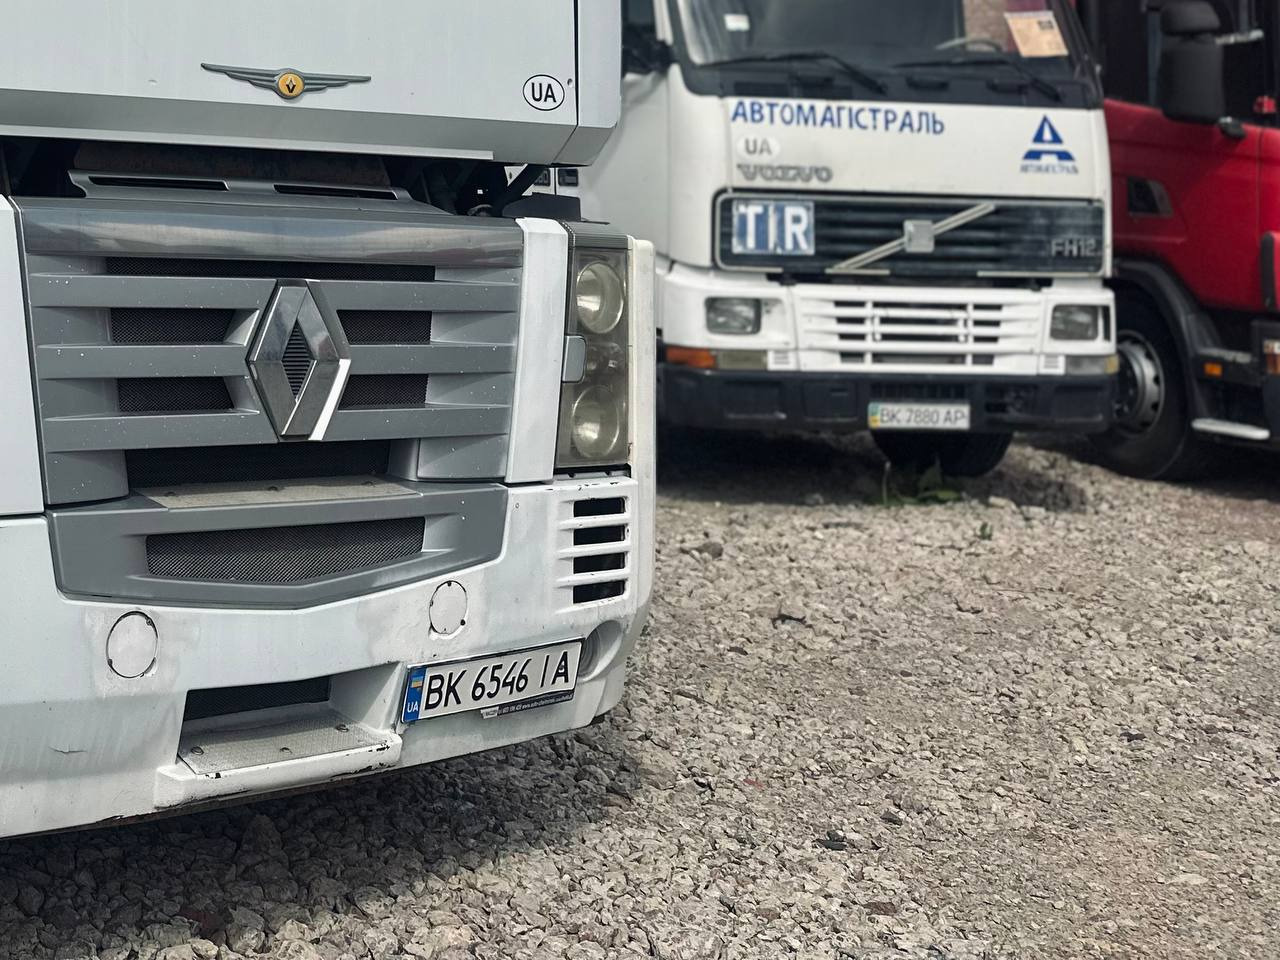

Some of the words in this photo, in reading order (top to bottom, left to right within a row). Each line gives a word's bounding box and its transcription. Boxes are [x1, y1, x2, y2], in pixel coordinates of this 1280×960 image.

[531, 82, 557, 103] UA
[731, 100, 946, 136] АВТОМАГІСТРАЛЬ
[745, 138, 772, 156] UA
[736, 163, 834, 183] VOLVO
[738, 204, 809, 252] TIR
[1051, 238, 1097, 257] FH12
[424, 669, 468, 711] BK
[471, 658, 532, 702] 6546
[407, 700, 419, 714] UA
